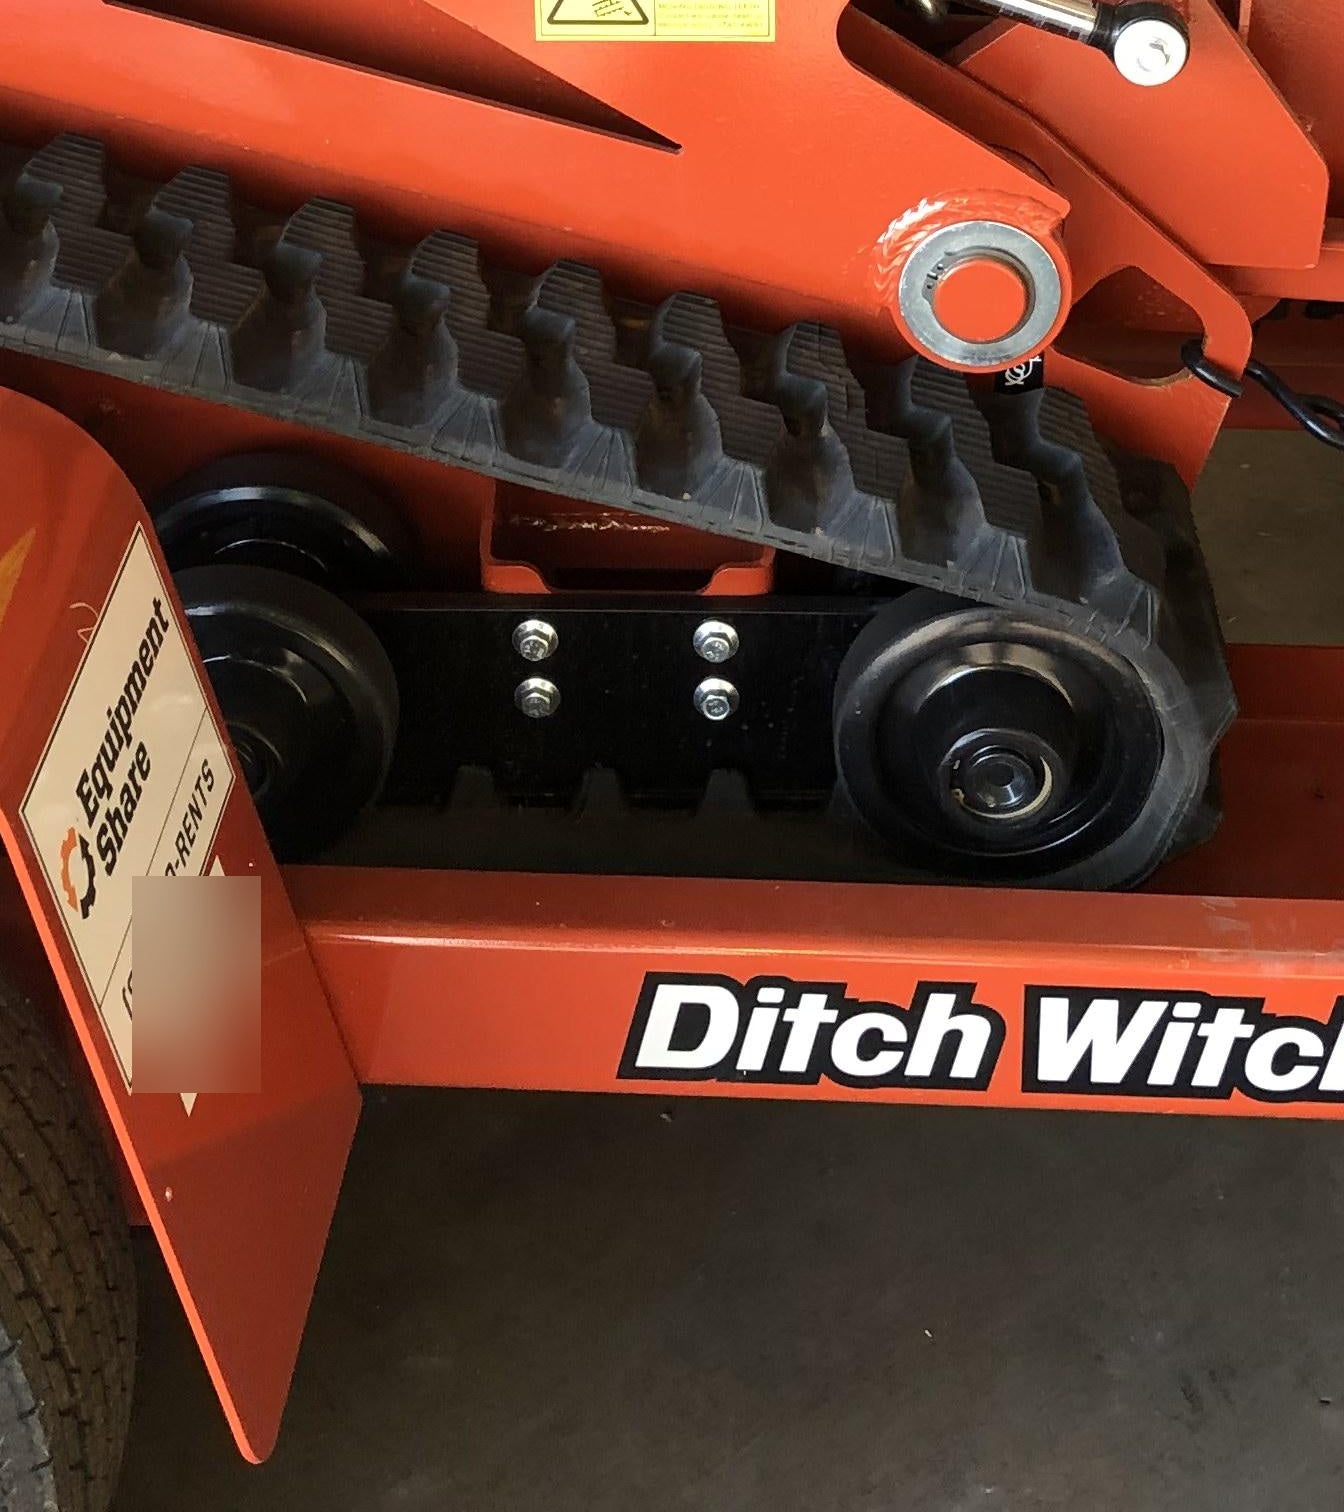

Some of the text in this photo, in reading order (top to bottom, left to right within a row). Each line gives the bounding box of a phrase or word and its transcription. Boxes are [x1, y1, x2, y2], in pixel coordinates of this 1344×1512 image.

[75, 596, 170, 829] Equipment
[95, 740, 152, 877] Share
[633, 982, 993, 1082] Ditch
